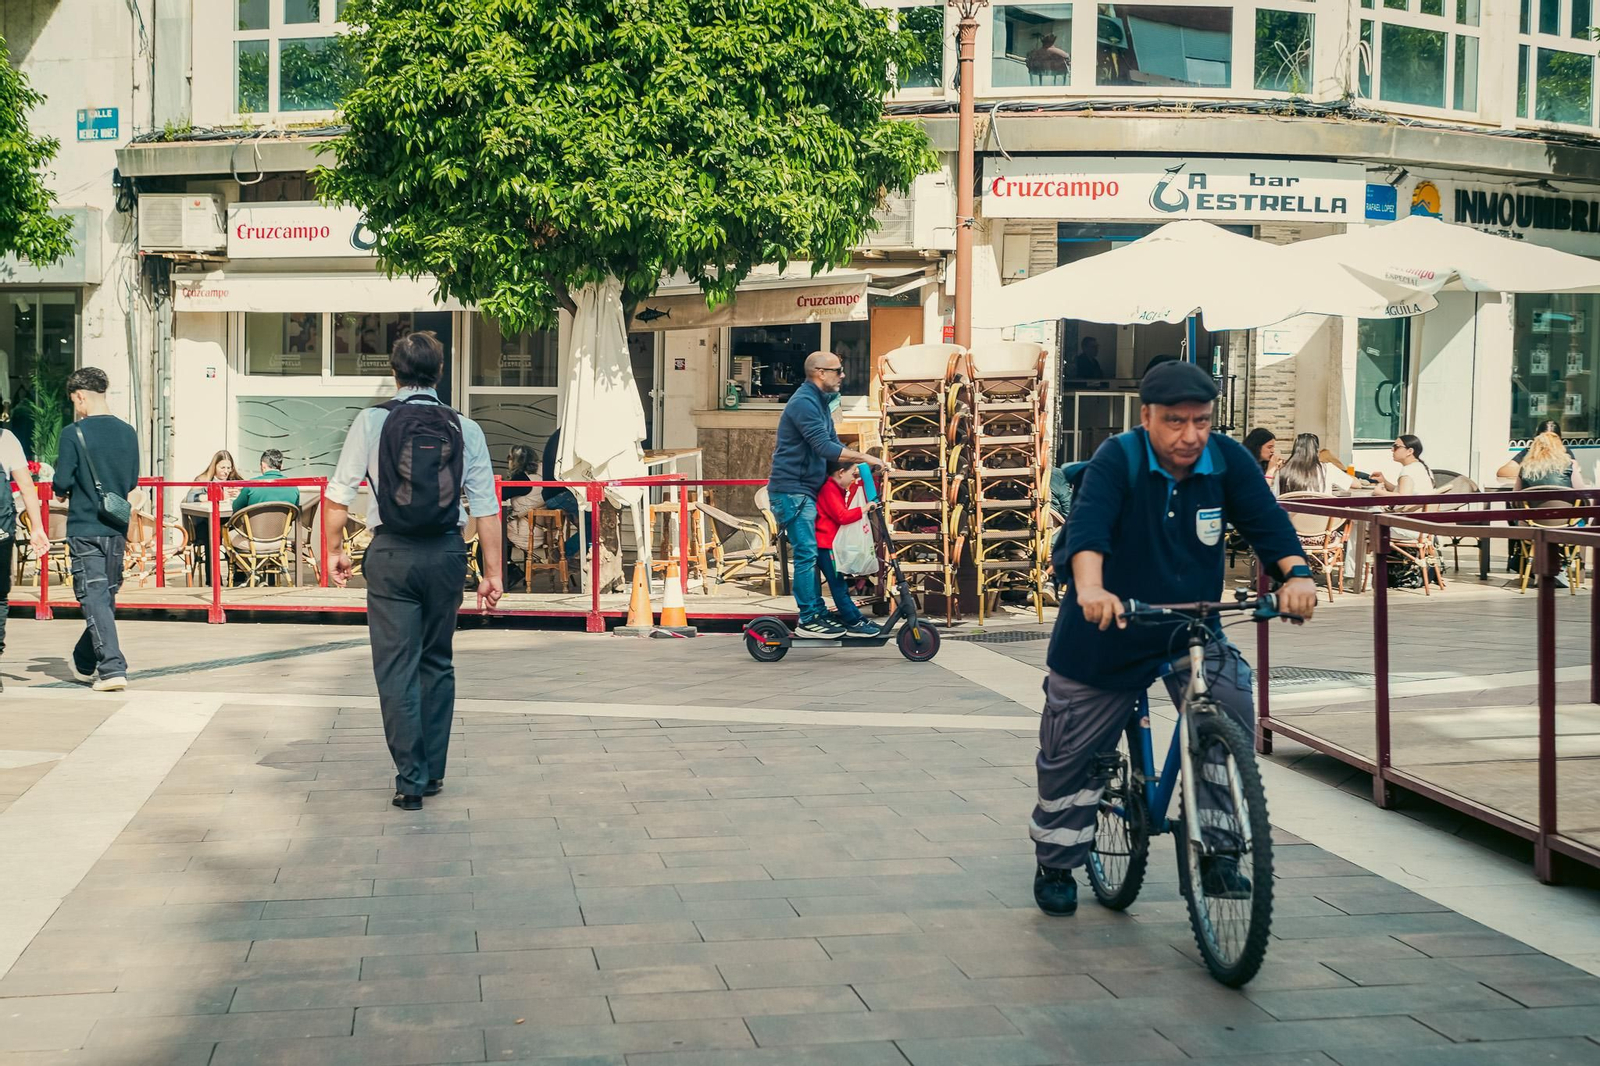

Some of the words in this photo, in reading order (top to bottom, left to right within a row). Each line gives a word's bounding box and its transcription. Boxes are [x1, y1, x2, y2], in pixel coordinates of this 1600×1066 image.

[992, 175, 1119, 201] Cruzcampo
[1250, 173, 1299, 187] bar
[1196, 193, 1347, 214] ESTRELLA
[1454, 188, 1600, 233] INMOUMBRI
[236, 223, 330, 242] Cruzcampo
[797, 293, 860, 307] Cruzcampo
